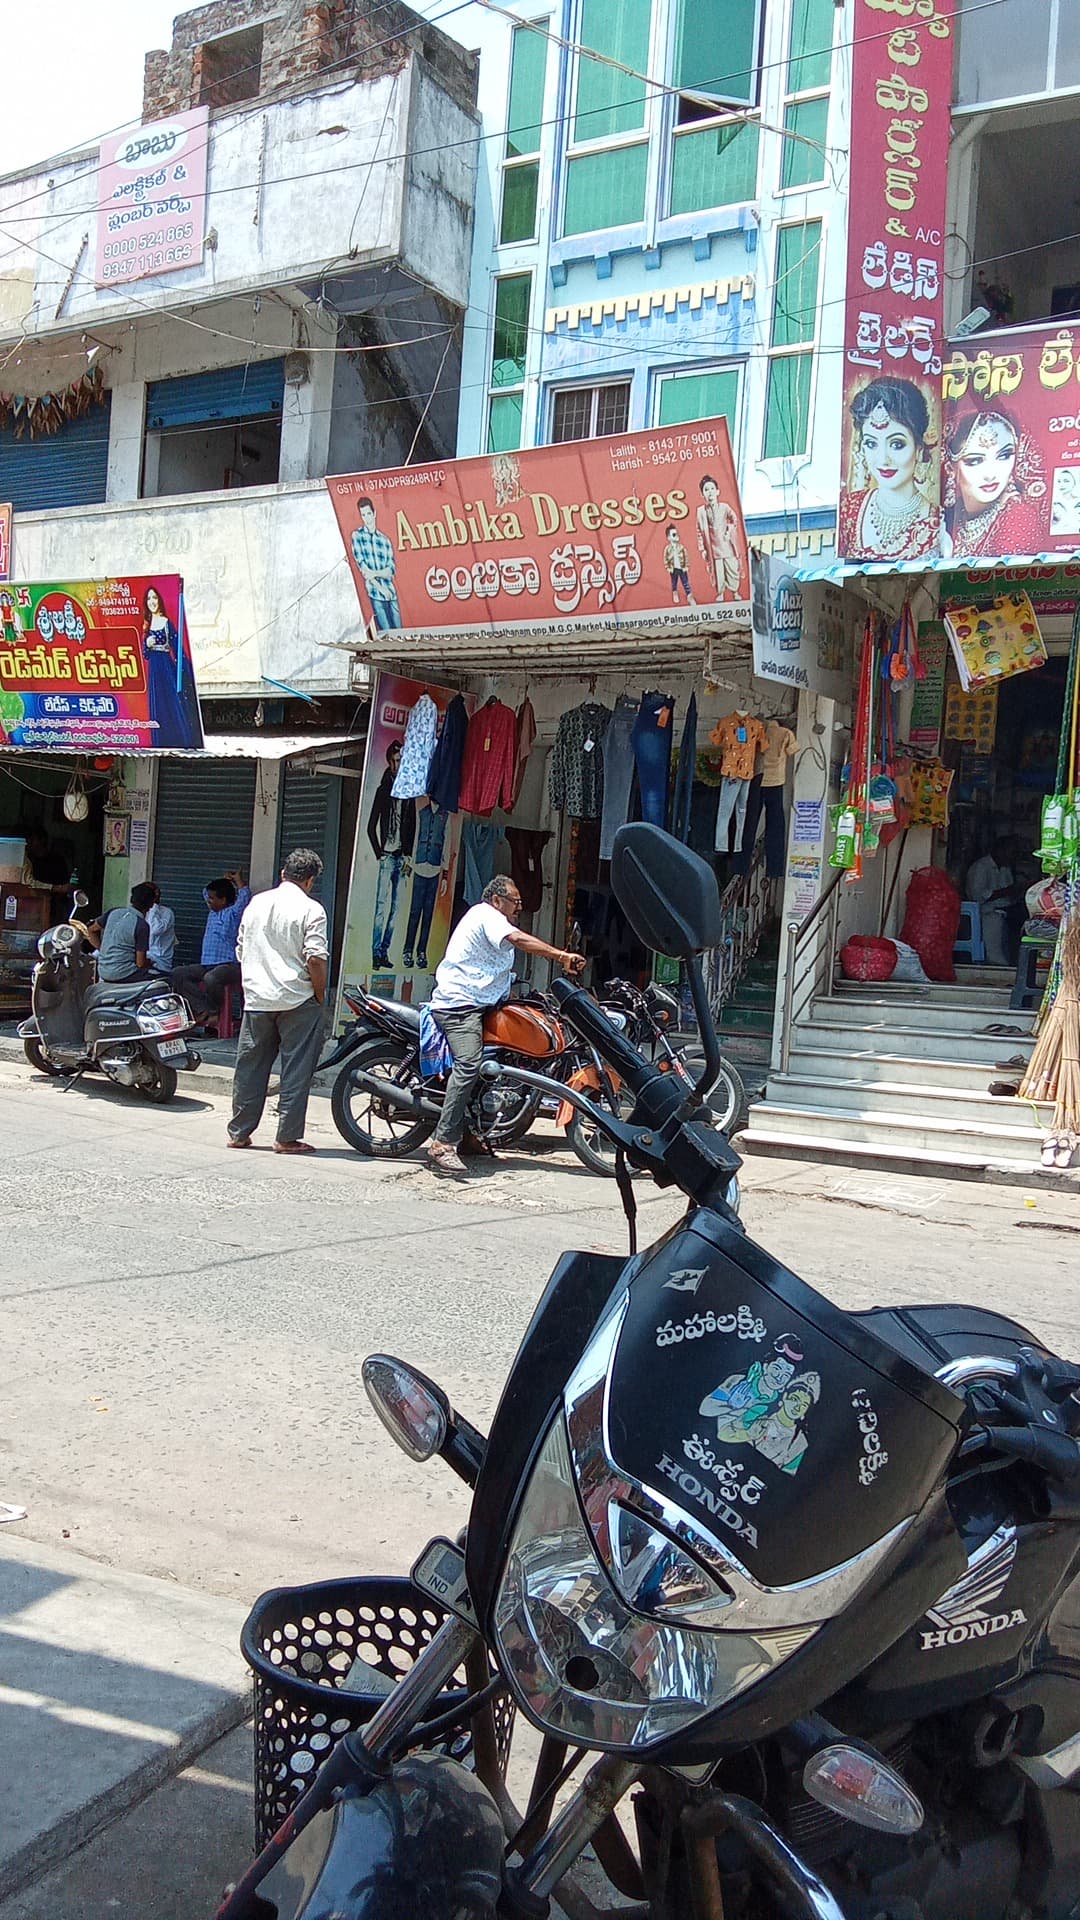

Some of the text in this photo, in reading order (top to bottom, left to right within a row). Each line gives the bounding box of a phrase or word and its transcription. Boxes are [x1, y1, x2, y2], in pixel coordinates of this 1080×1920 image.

[125, 131, 175, 163] బాబు
[174, 165, 186, 180] &
[104, 223, 193, 259] 9000 524 865
[885, 217, 941, 246] & A/C
[102, 244, 192, 279] 9347 113 669
[610, 443, 637, 458] Lalith
[649, 437, 674, 451] 8143
[676, 435, 688, 447] 77
[691, 430, 718, 445] 9001
[612, 458, 643, 472] Harish
[652, 451, 678, 466] 9542
[680, 449, 693, 461] 06
[696, 444, 721, 458] 1581
[337, 482, 353, 495] GST
[354, 481, 364, 493] IN
[396, 489, 690, 551] Ambika Dresses
[424, 556, 541, 603] అంబికా
[717, 610, 734, 620] 522
[736, 608, 752, 618] 601
[779, 588, 803, 610] Max
[656, 1305, 768, 1347] మహాలక్ష్మి
[655, 1452, 759, 1550] HONDA
[427, 1574, 449, 1594] IND
[919, 1608, 1028, 1651] HONDA
